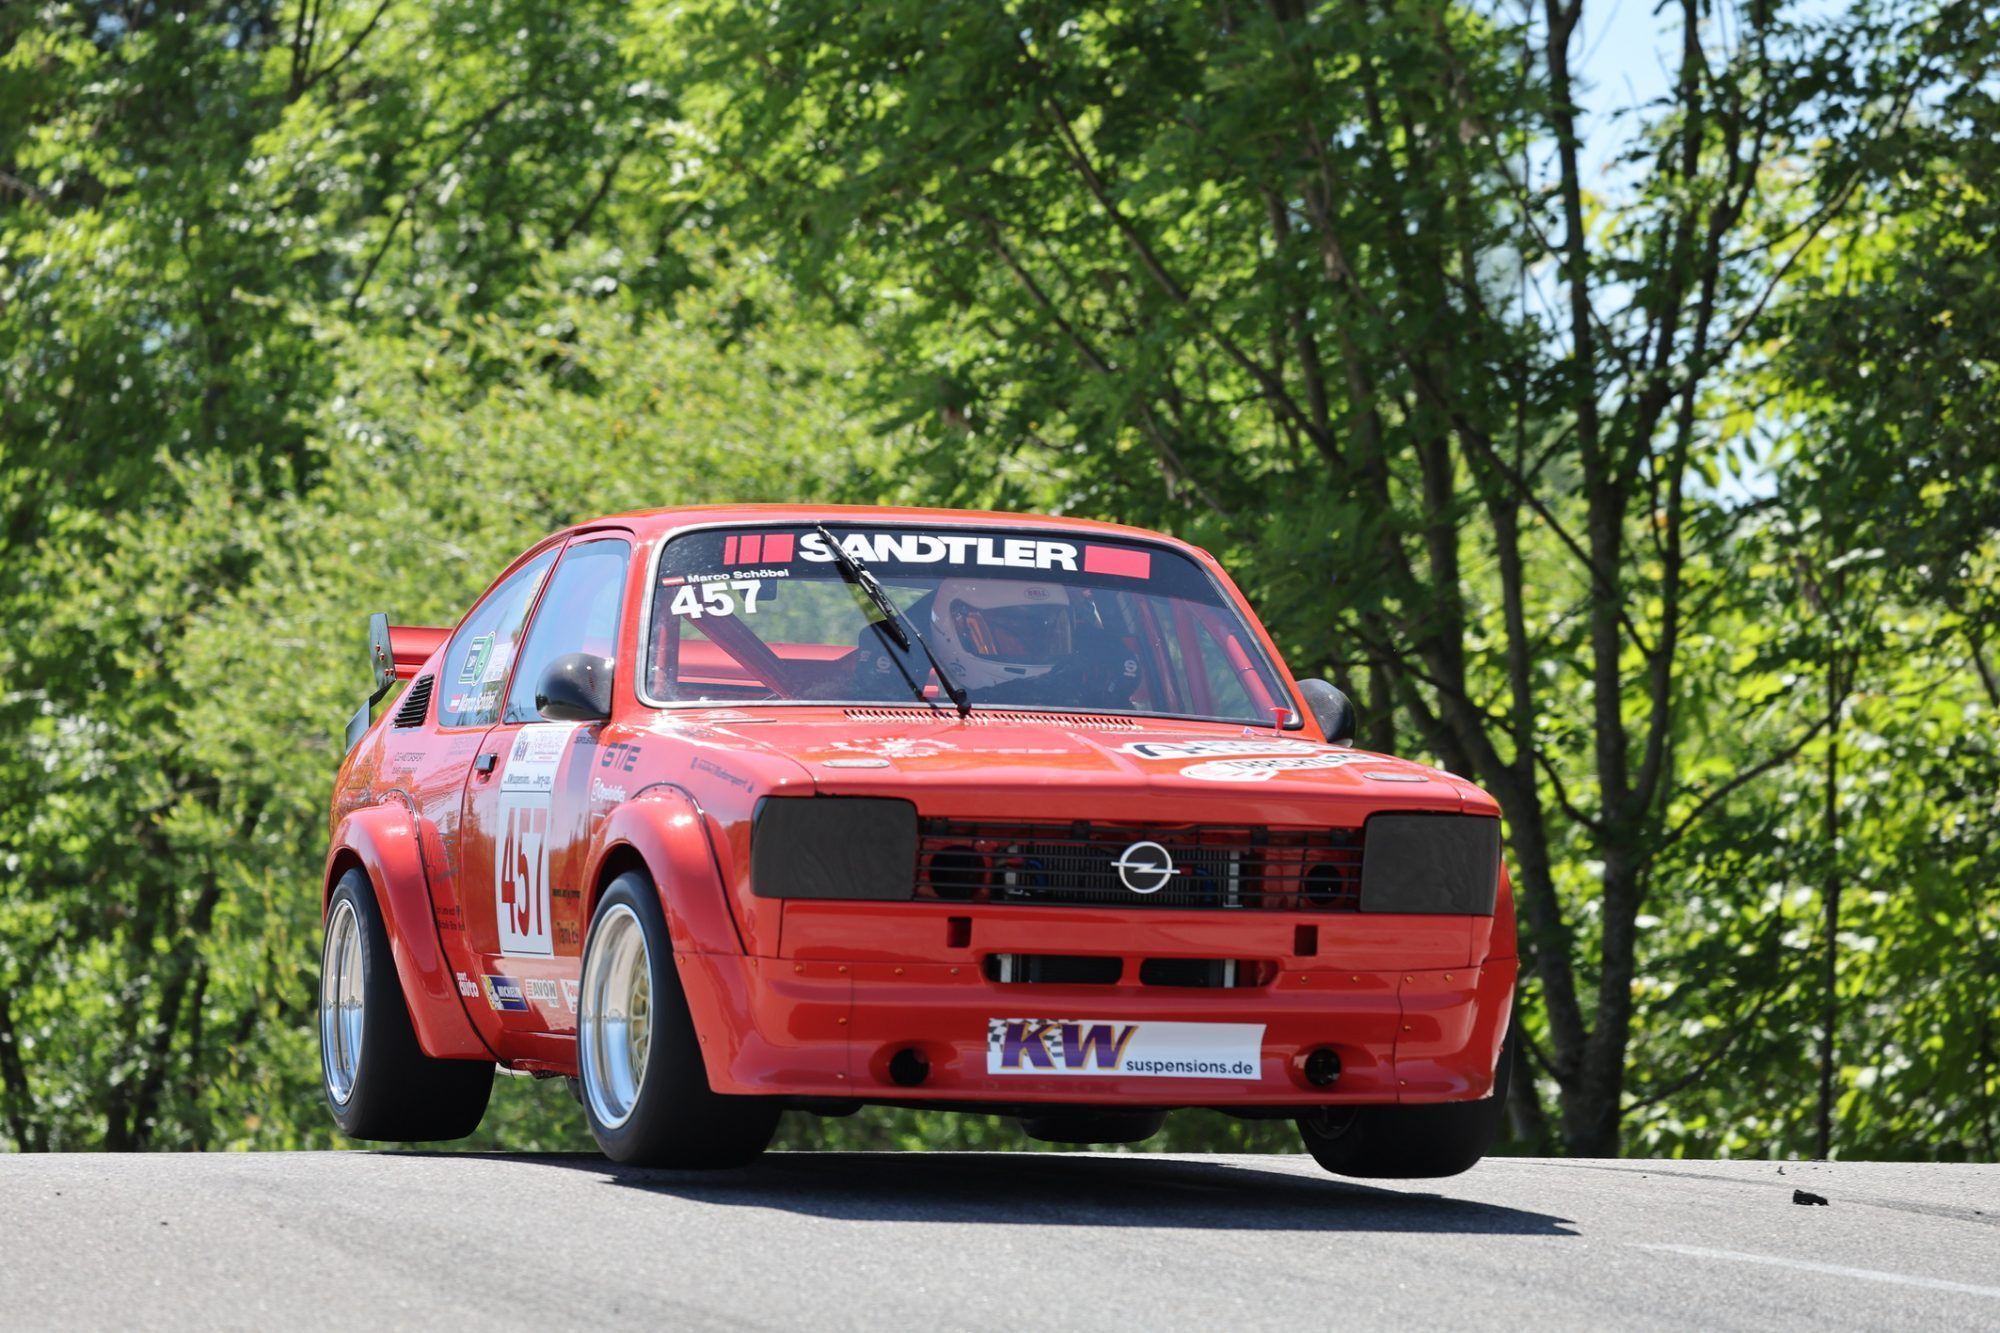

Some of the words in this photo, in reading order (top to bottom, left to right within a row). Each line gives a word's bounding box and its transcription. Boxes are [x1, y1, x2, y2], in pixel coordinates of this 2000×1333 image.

[799, 533, 1078, 571] SANDTLER
[687, 573, 730, 583] Marco
[733, 569, 790, 579] Schöbel
[670, 579, 761, 618] 457
[601, 742, 641, 772] GTE
[501, 807, 548, 937] 457
[533, 980, 557, 997] AVON
[1000, 1023, 1139, 1070] KW
[1126, 1059, 1253, 1074] suspensions.de
